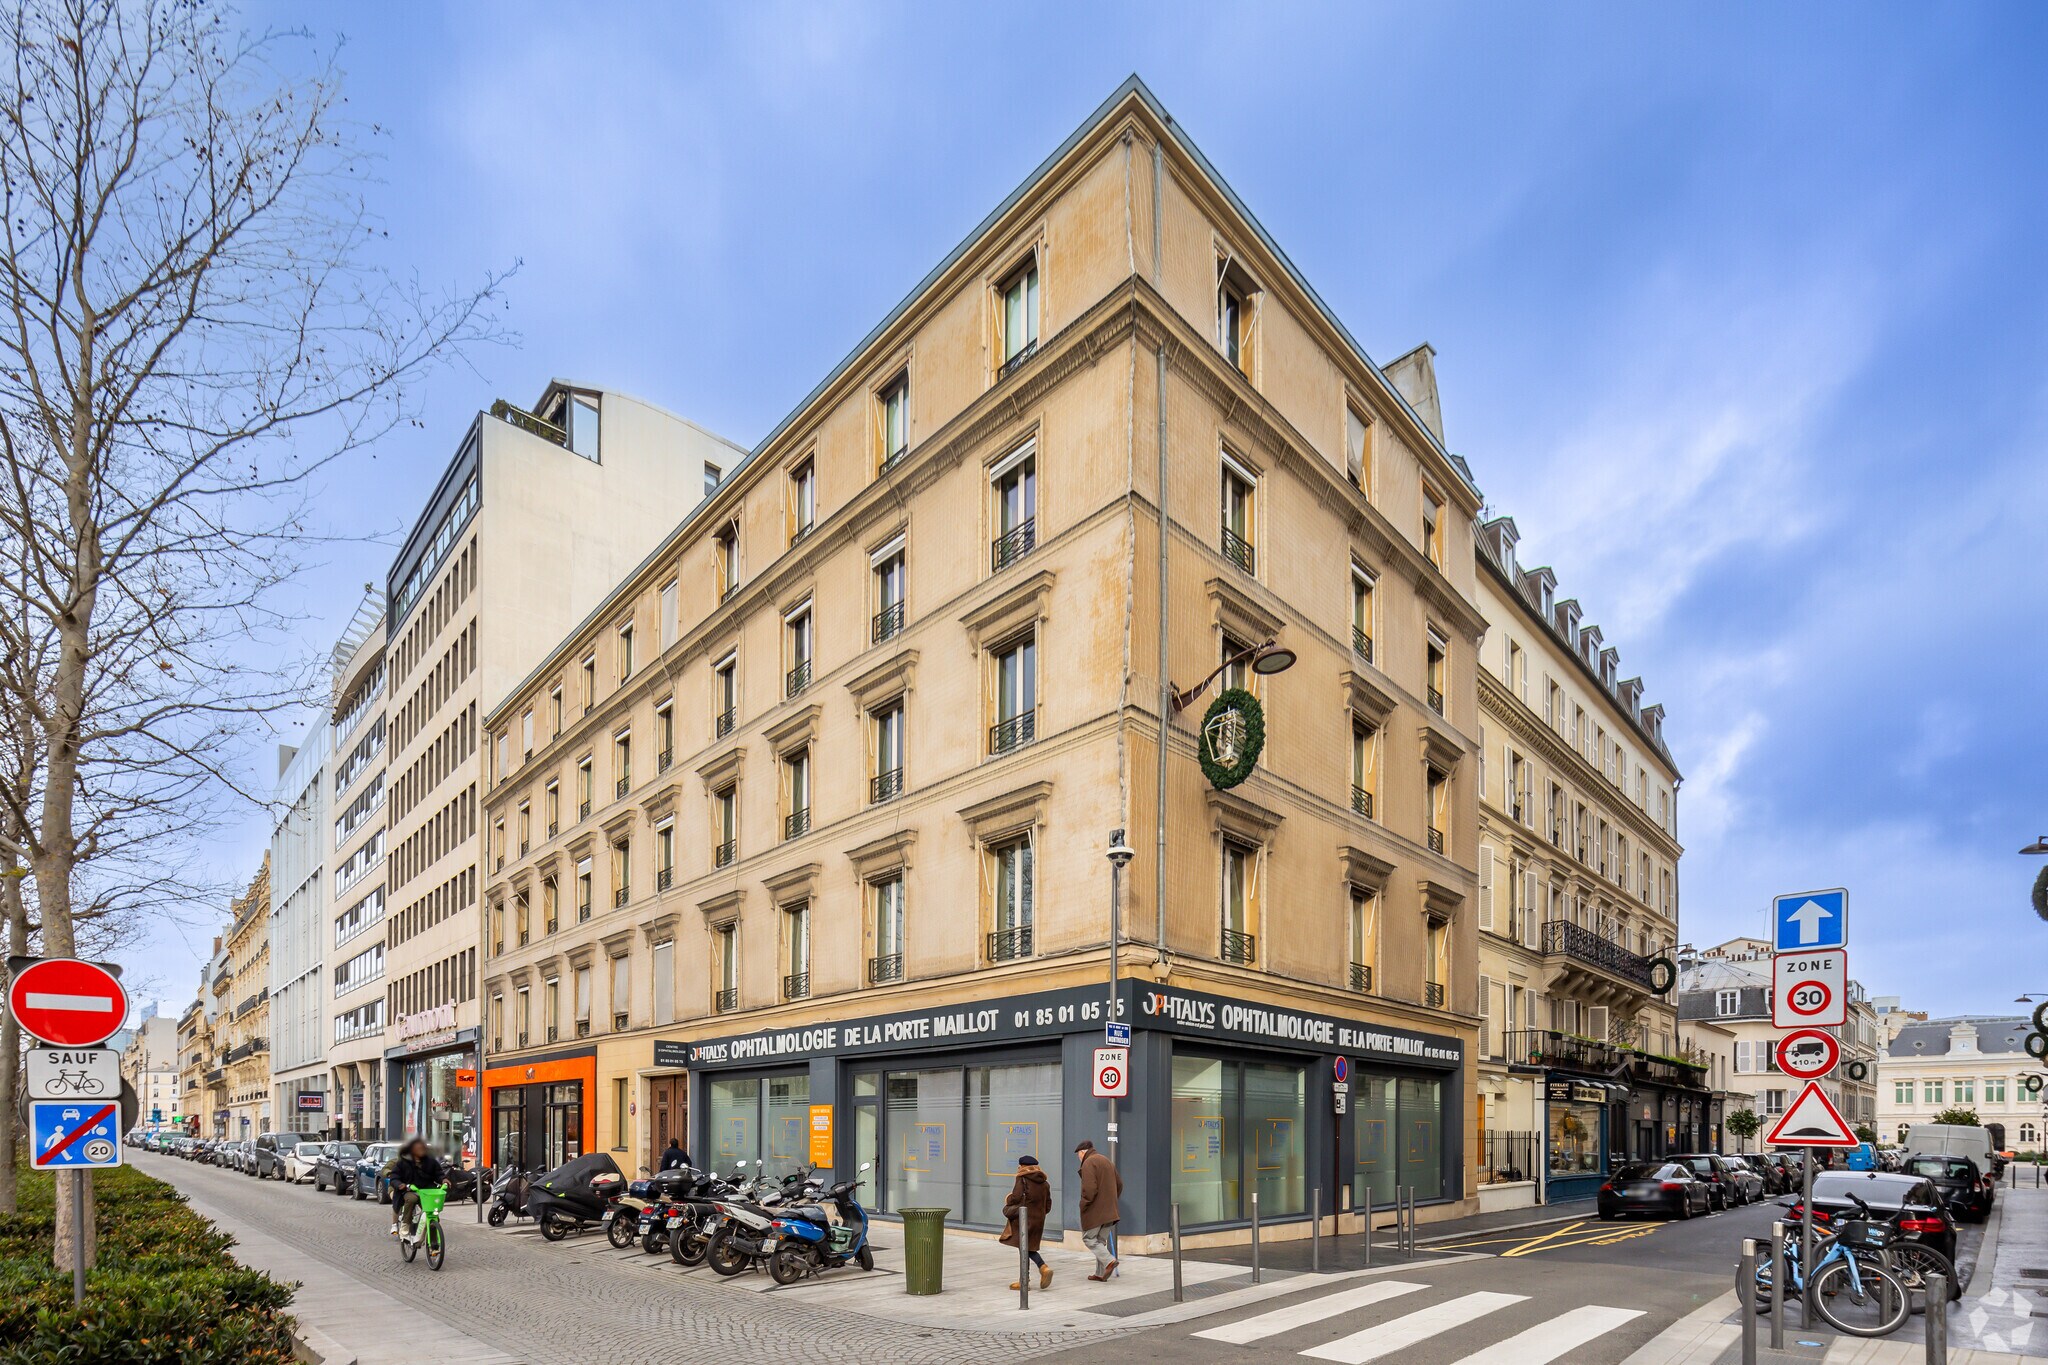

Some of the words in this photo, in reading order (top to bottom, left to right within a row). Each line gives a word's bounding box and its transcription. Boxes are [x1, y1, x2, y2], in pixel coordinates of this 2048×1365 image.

[1787, 959, 1832, 972] ZONE
[1796, 990, 1822, 1006] 30
[1014, 1010, 1030, 1028] 01
[1035, 1007, 1053, 1026] 85
[1058, 1004, 1074, 1023] 01
[1081, 1001, 1100, 1020] 05
[731, 1027, 837, 1059] OPHTALMOLOGIE
[844, 1027, 861, 1047] DE
[864, 1024, 881, 1045] LA
[885, 1018, 930, 1042] PORTE
[933, 1009, 999, 1037] MAILLOT
[1222, 1005, 1334, 1044] OPHTALMOLOGIE
[1339, 1028, 1351, 1047] DE
[1353, 1030, 1365, 1049] LA
[1366, 1032, 1392, 1052] PORTE
[1393, 1035, 1424, 1057] MAILLOT
[1424, 1047, 1431, 1058] 01
[1432, 1048, 1439, 1059] 85
[1439, 1049, 1446, 1060] 01
[1446, 1050, 1453, 1060] 05
[1453, 1051, 1460, 1061] 75
[48, 1052, 98, 1064] SAUF
[1104, 1072, 1116, 1083] 30
[90, 1146, 108, 1156] 20
